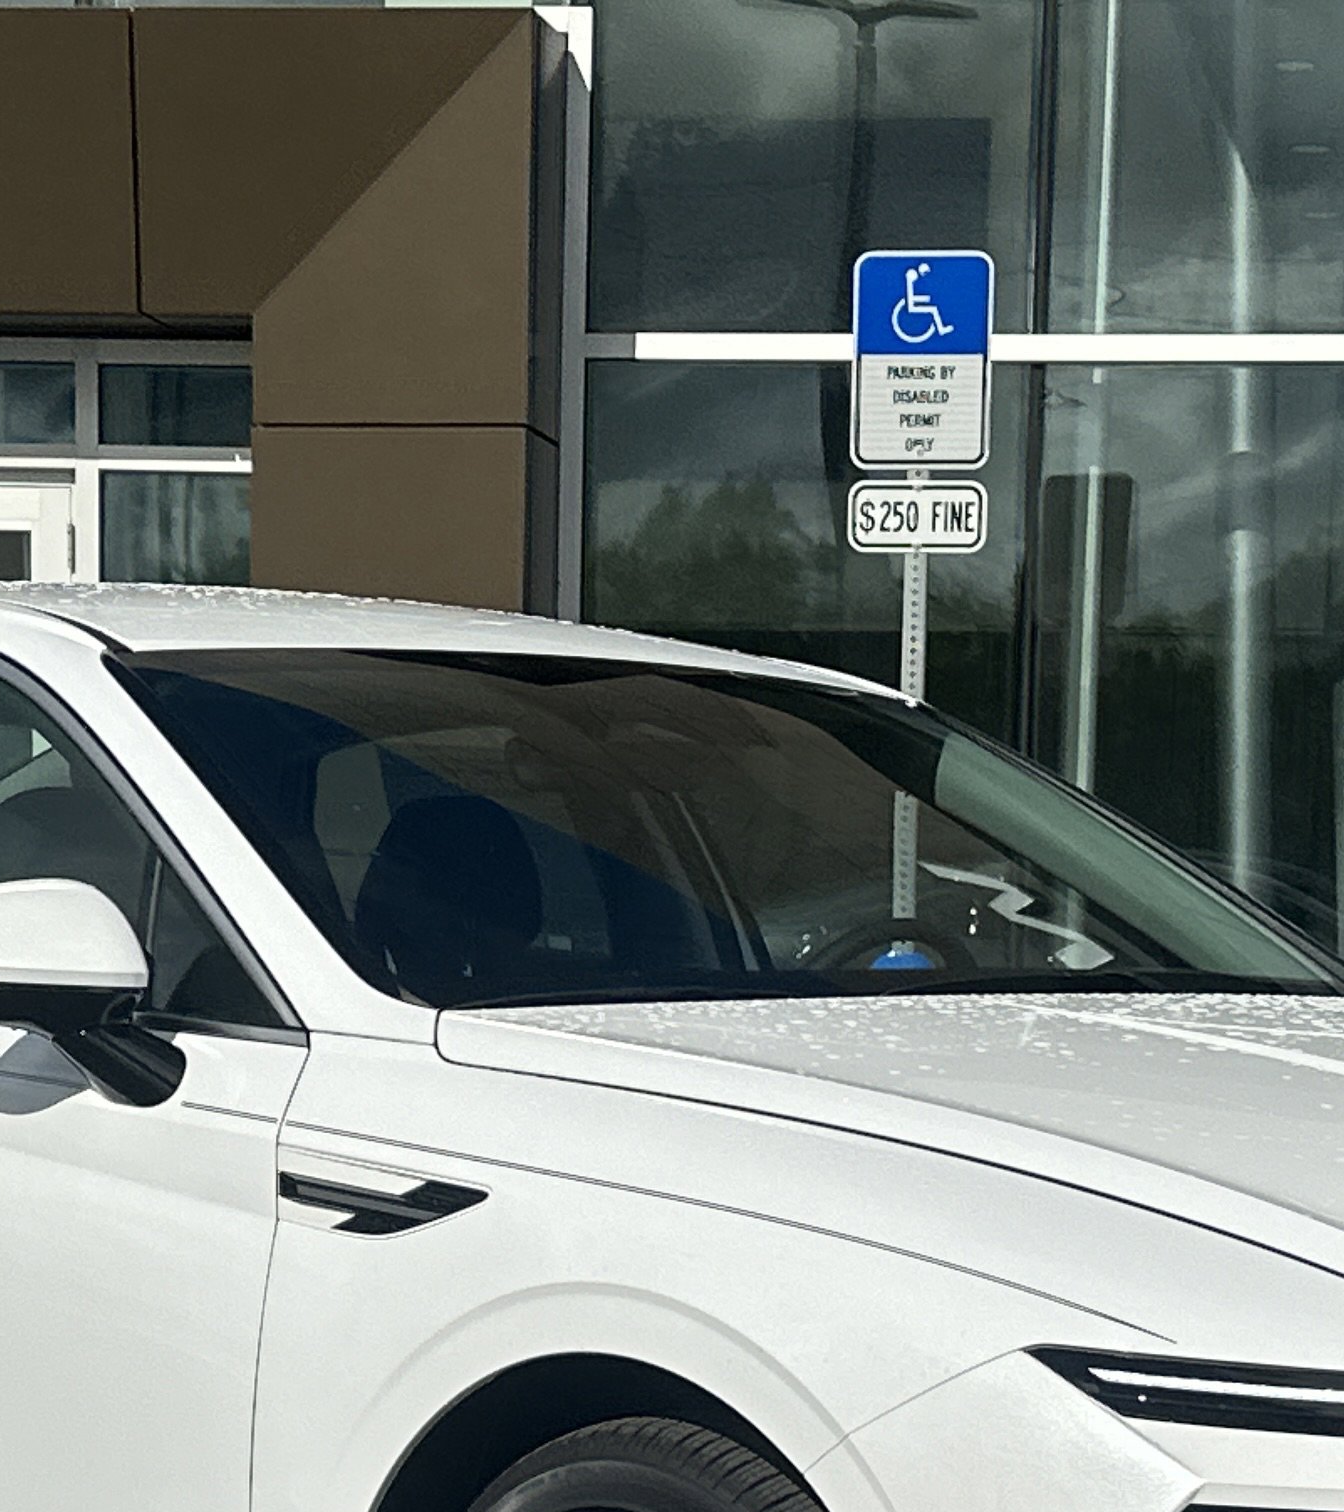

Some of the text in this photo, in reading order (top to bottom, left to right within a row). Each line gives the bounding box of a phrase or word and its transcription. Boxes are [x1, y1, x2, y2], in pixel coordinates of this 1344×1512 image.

[886, 365, 956, 380] PARKING BY
[893, 390, 950, 404] DISABLED
[899, 413, 942, 428] PERMIT
[859, 500, 976, 535] $250 FINE
